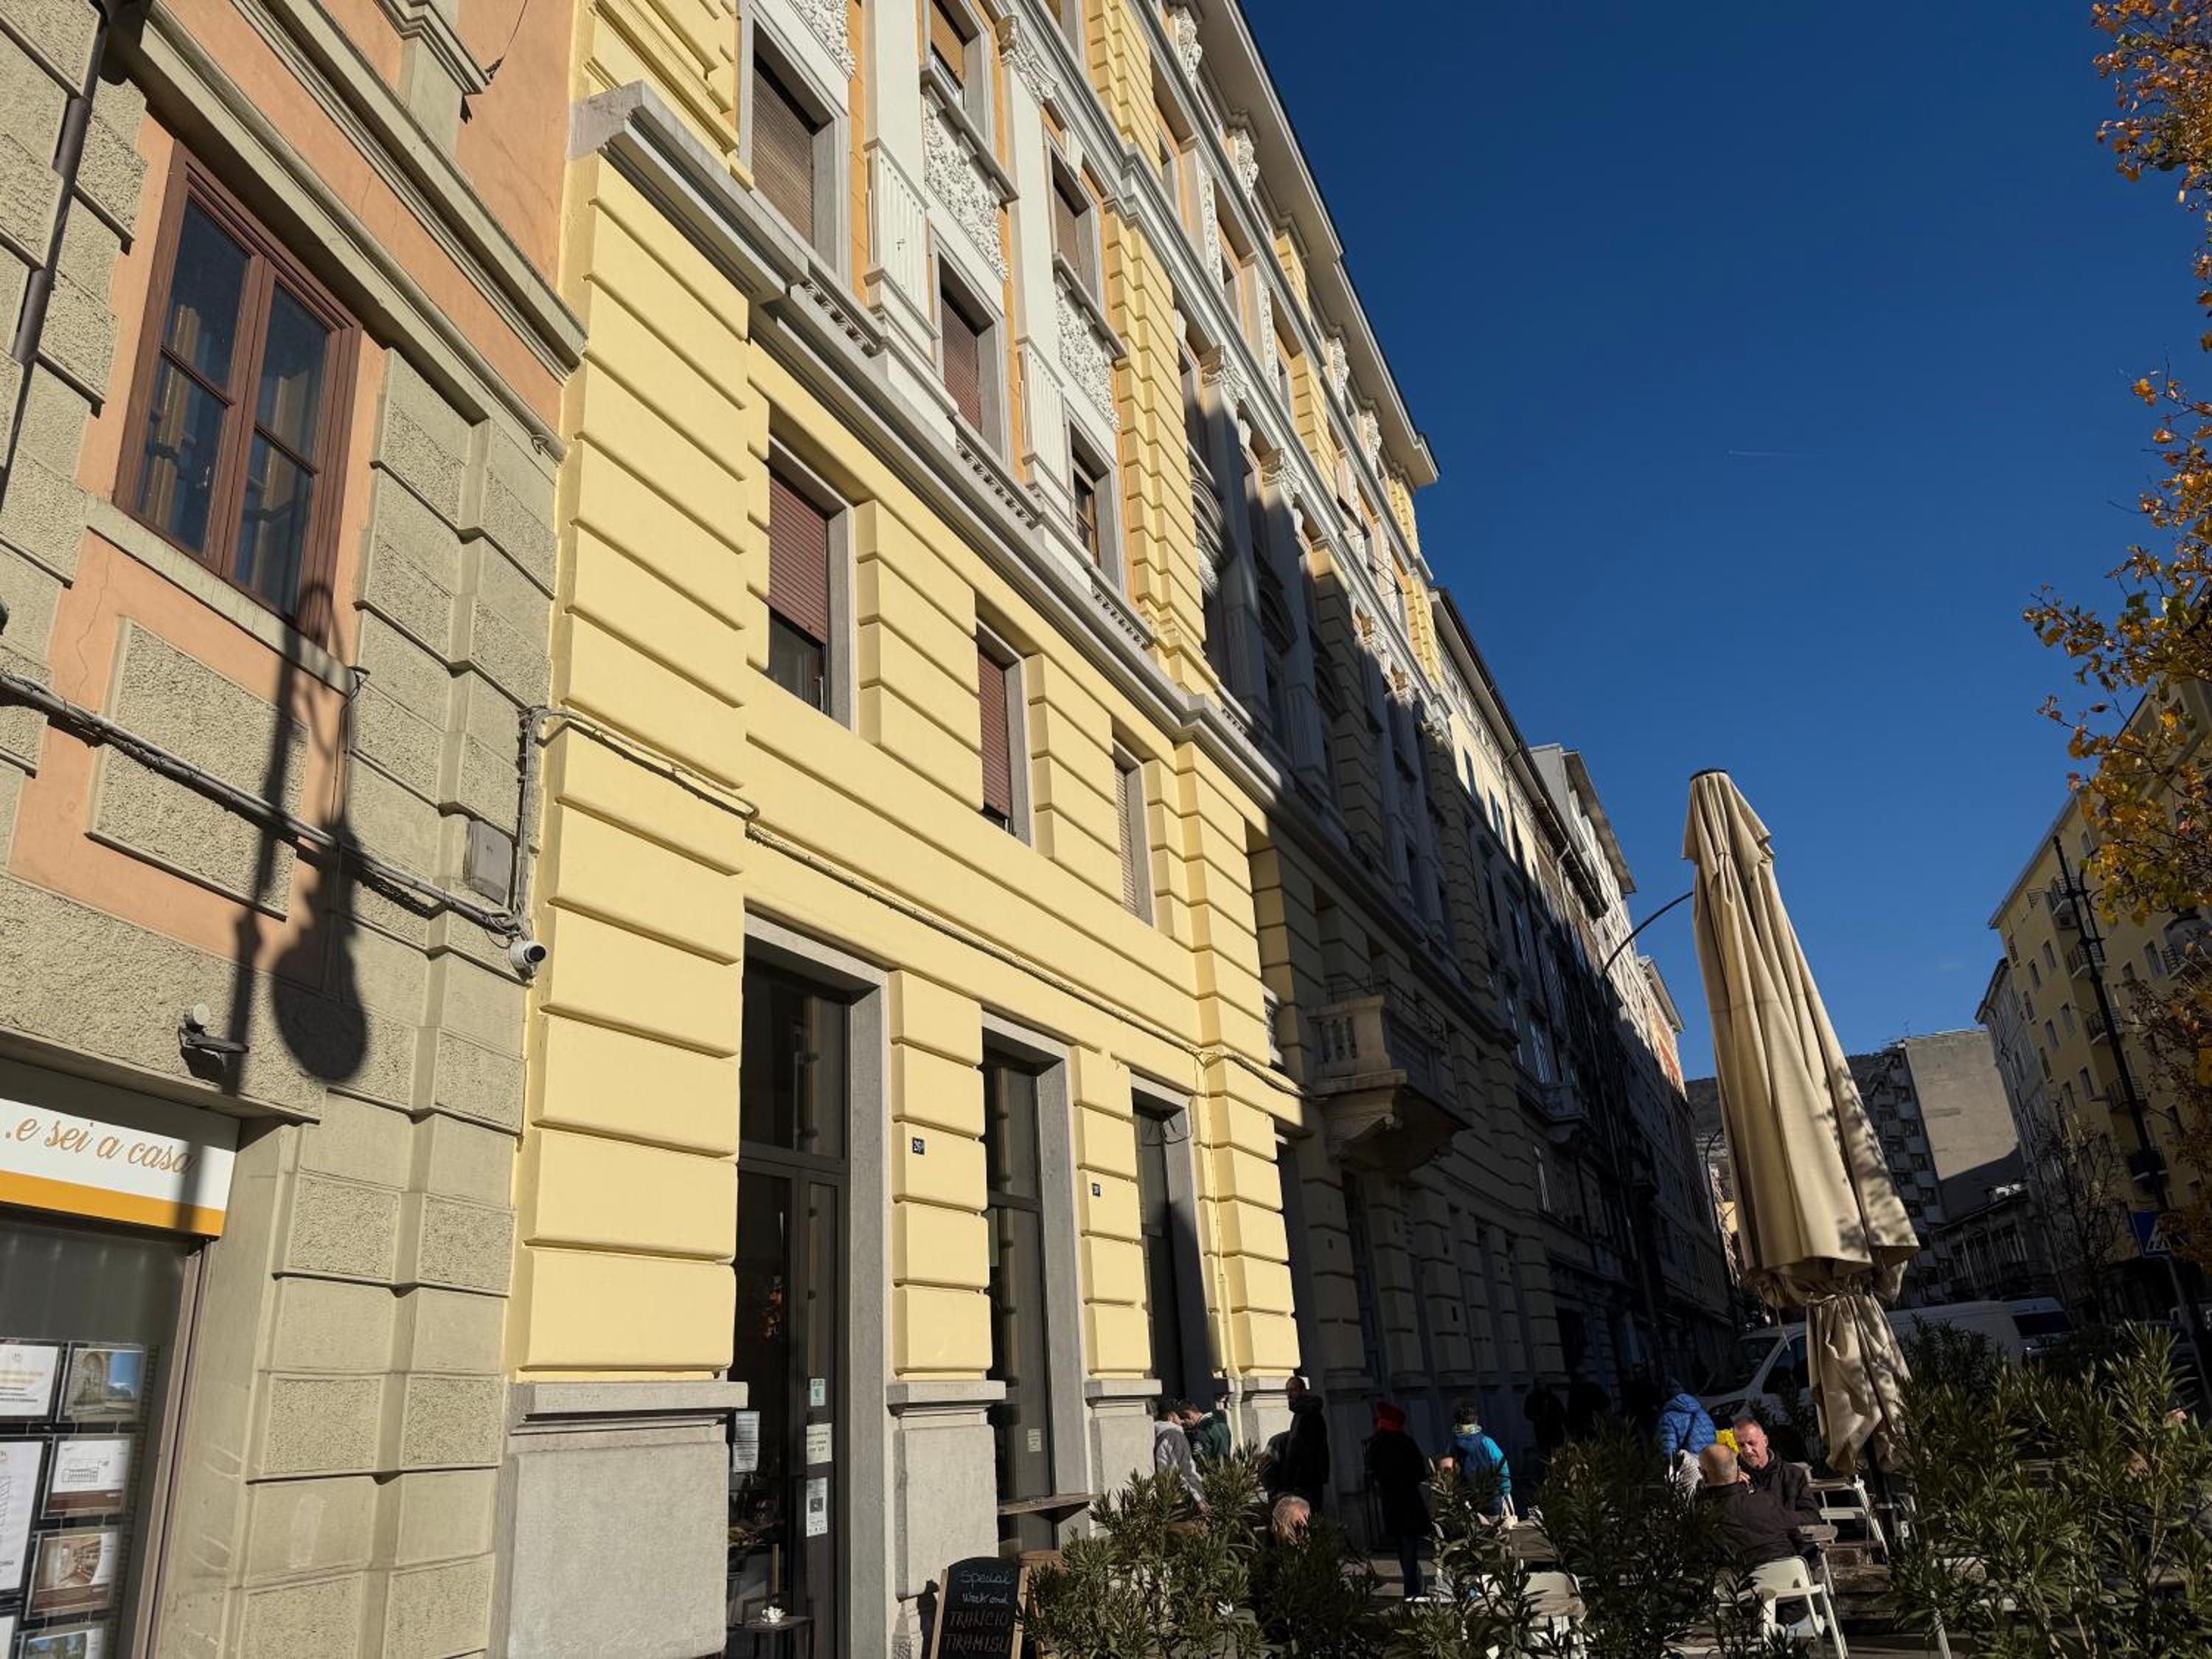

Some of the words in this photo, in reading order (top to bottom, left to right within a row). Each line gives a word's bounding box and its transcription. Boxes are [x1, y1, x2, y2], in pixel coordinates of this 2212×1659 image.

[44, 1120, 94, 1152] sei
[97, 1135, 125, 1159] a
[128, 1142, 201, 1173] casa
